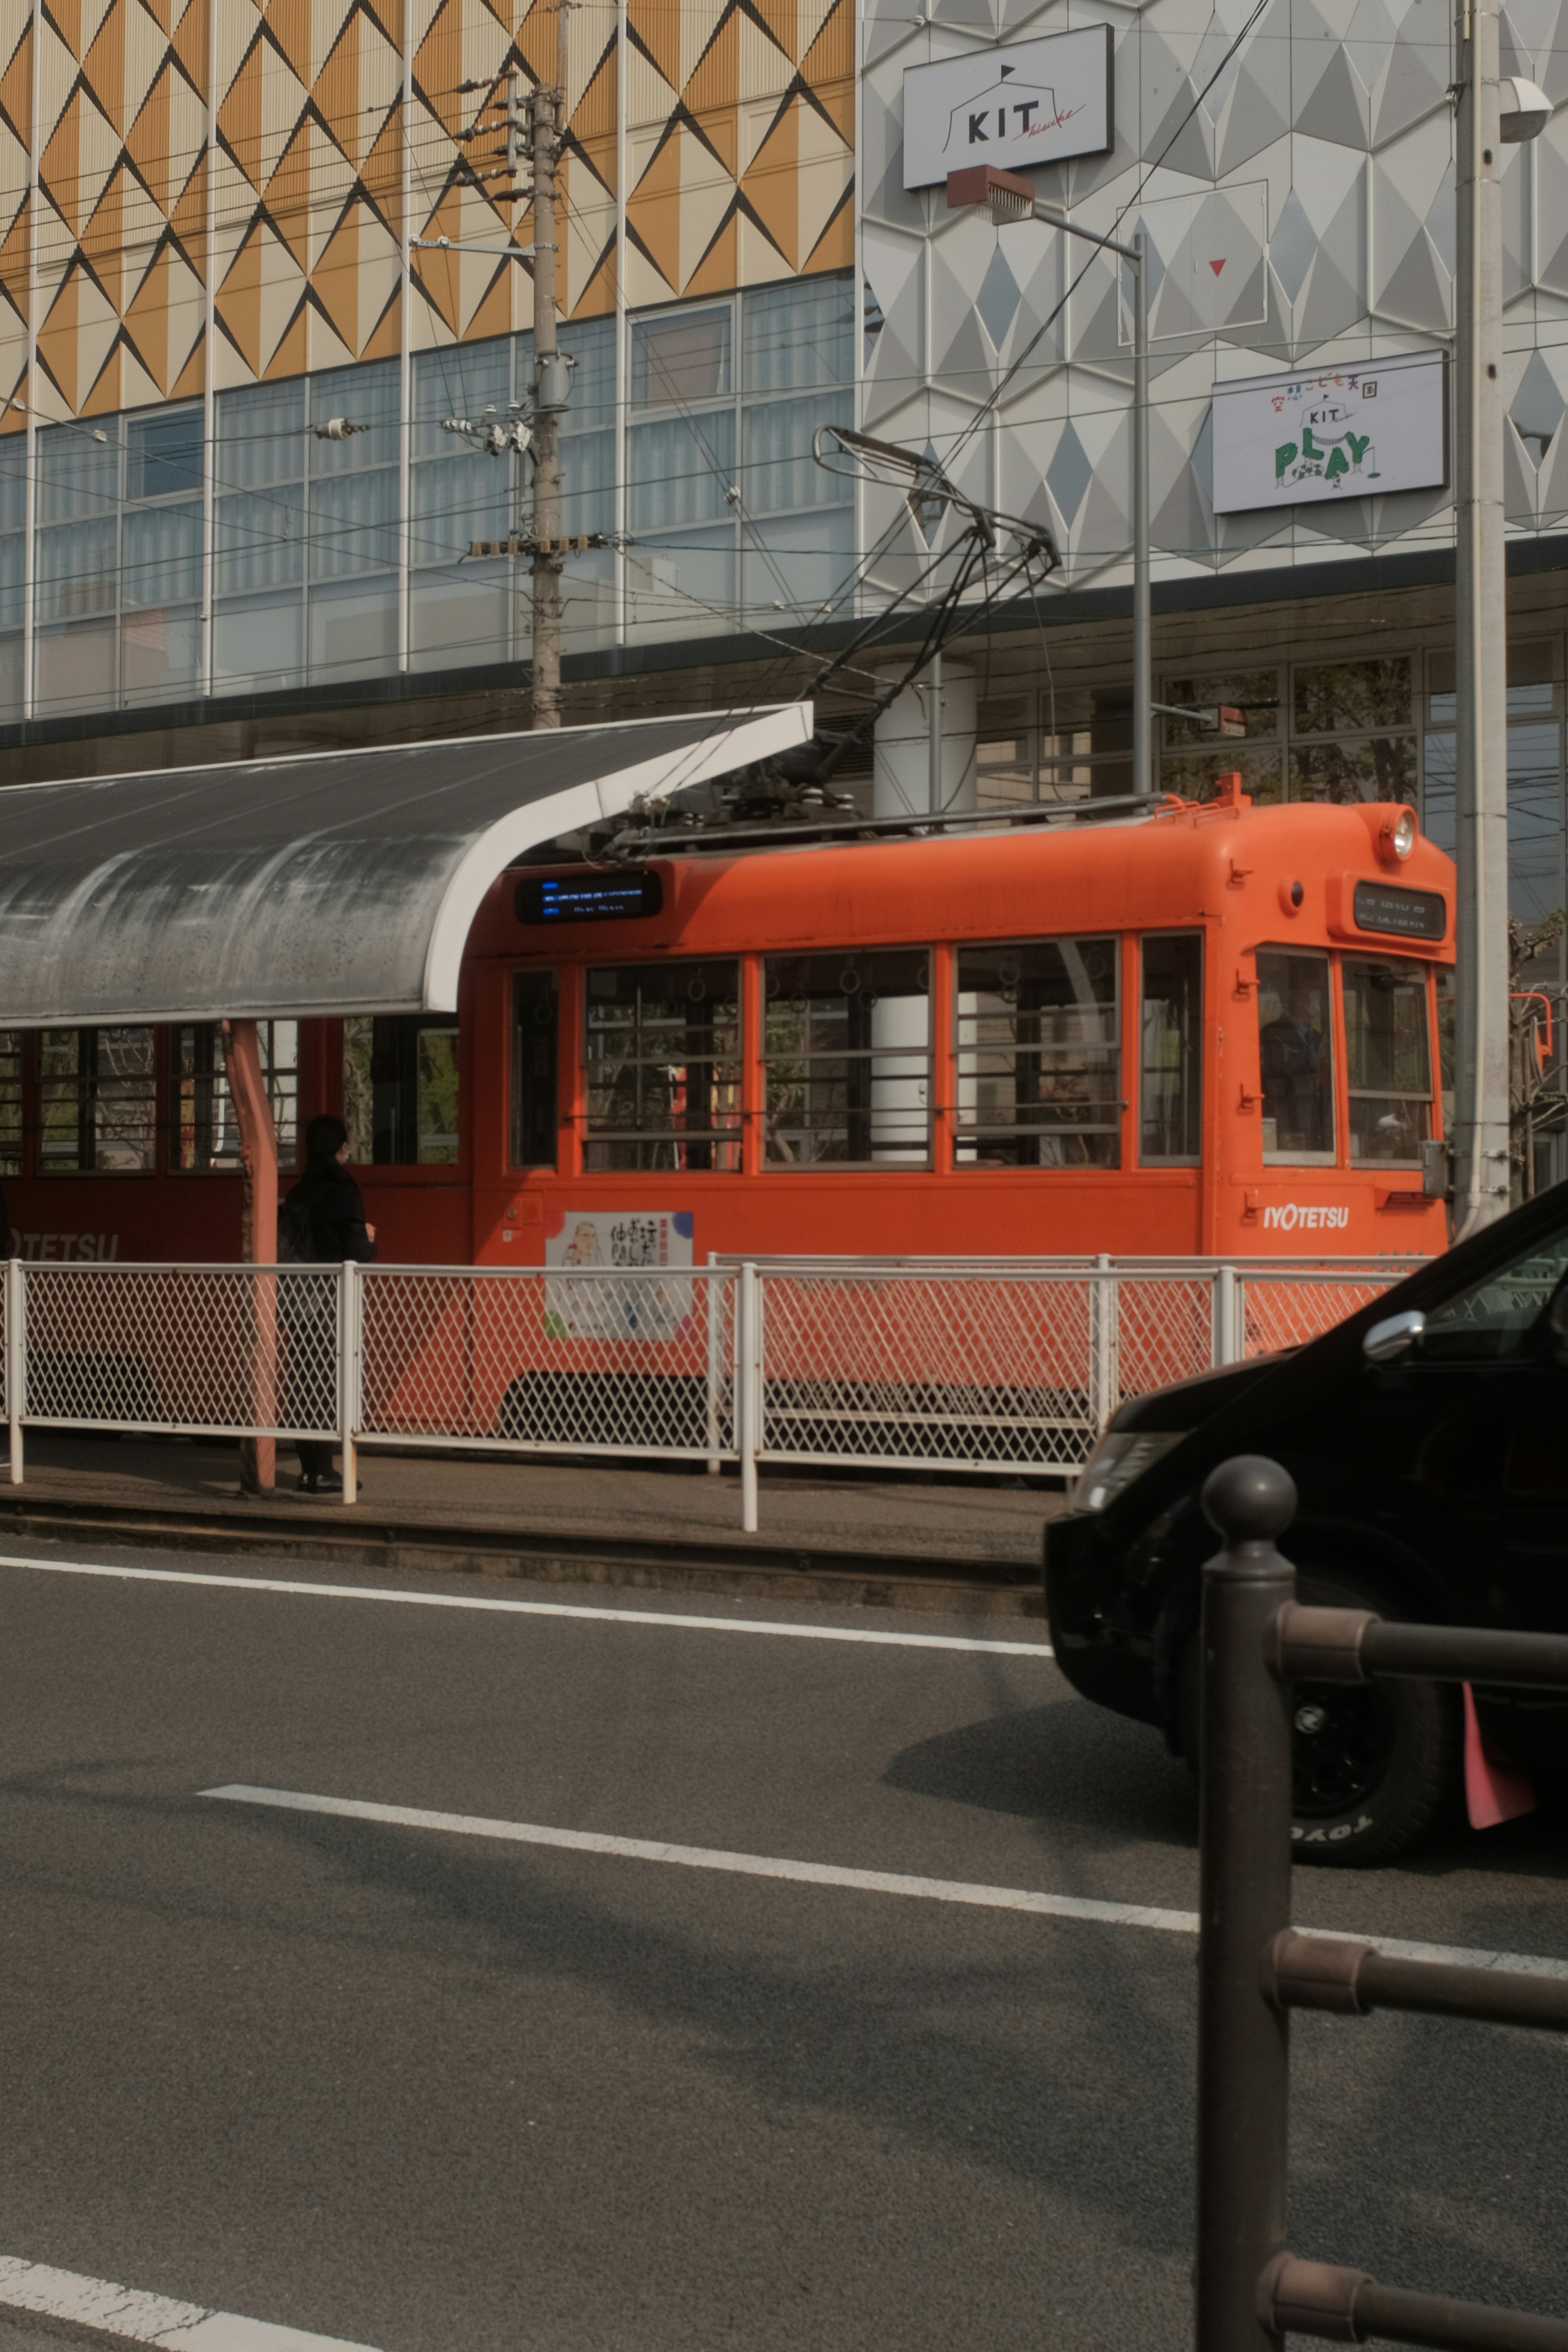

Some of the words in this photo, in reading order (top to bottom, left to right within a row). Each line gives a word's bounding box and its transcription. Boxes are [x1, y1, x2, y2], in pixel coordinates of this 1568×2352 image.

[969, 100, 1039, 144] KIT
[1310, 409, 1339, 424] KIT
[1275, 427, 1370, 480] PLAY
[1263, 1203, 1349, 1231] IYOTETSU
